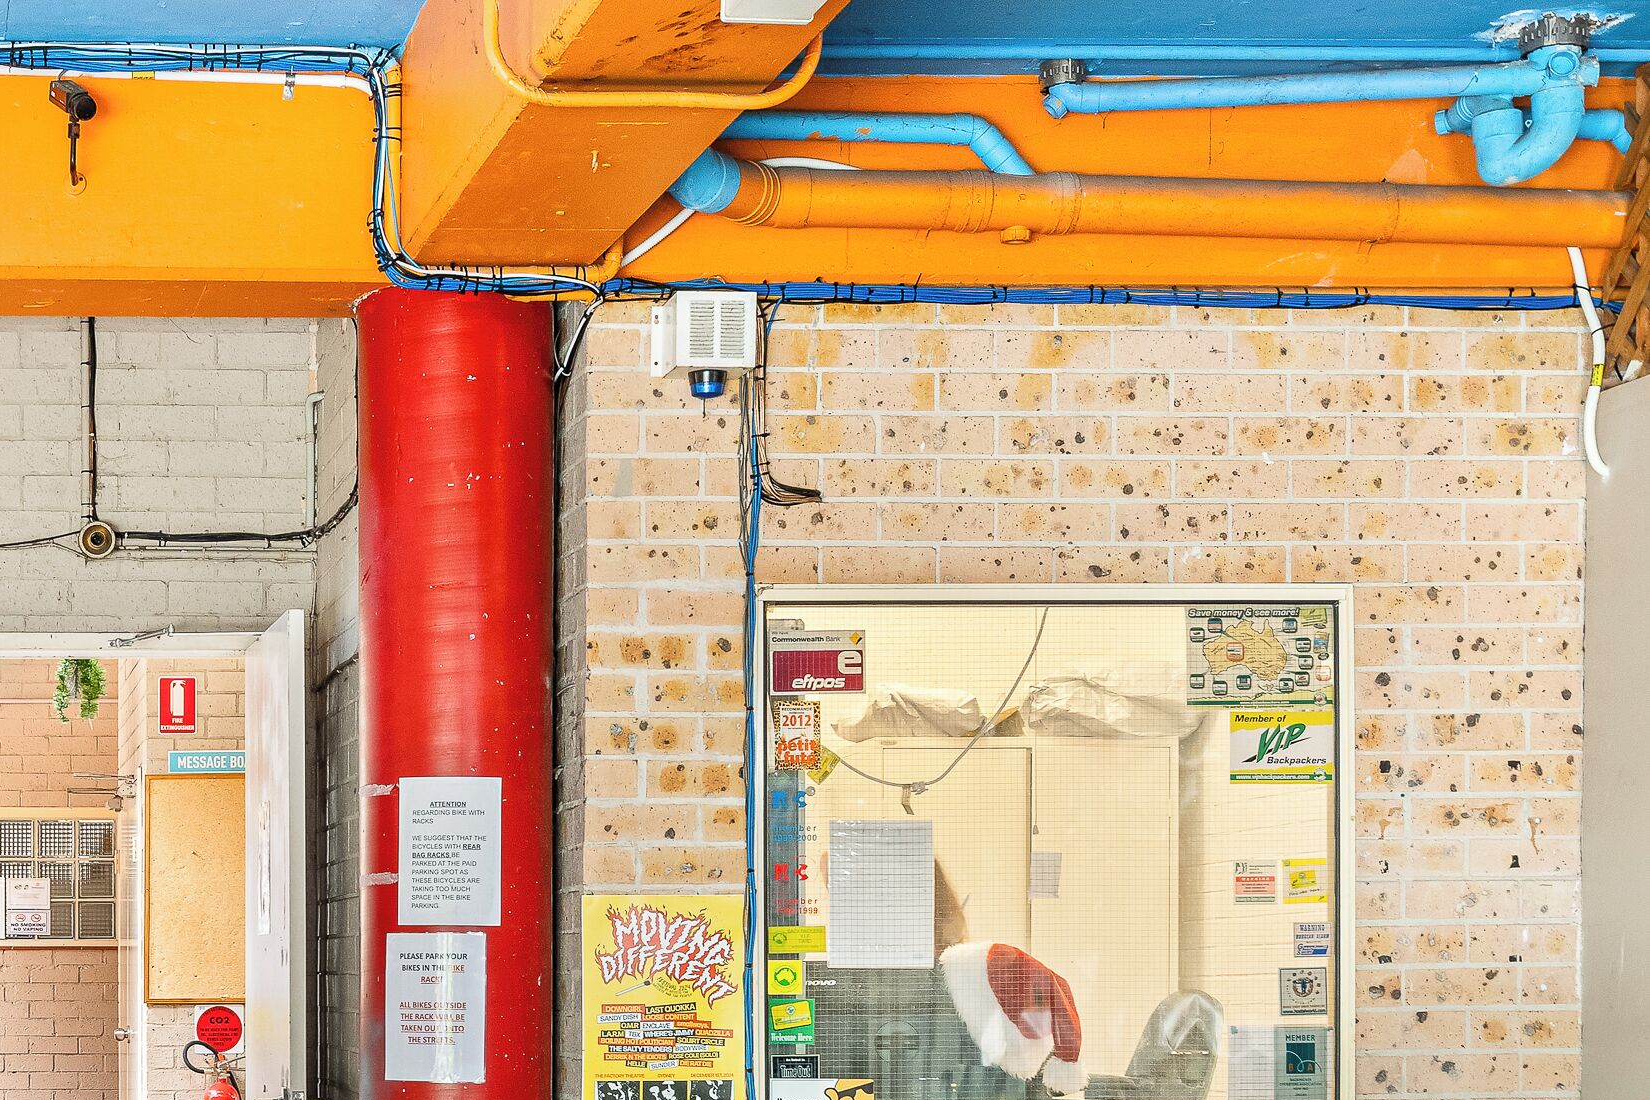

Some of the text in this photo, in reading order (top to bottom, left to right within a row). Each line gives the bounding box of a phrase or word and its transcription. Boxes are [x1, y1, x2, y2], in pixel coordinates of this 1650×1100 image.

[1188, 607, 1299, 618] Save money see more!
[772, 635, 841, 643] Commonwealth Bank
[837, 651, 862, 675] e
[792, 674, 846, 690] eftpos
[782, 715, 811, 727] 2012
[1235, 714, 1287, 723] Member of
[777, 738, 817, 756] petit
[178, 756, 245, 768] MESSAGE BO
[1267, 757, 1327, 766] Backpackers
[610, 908, 733, 967] MOVING
[600, 942, 738, 1008] DIFFERENT
[646, 1003, 695, 1014] LAST QUOKKA
[414, 1013, 434, 1021] RACK
[771, 1033, 812, 1041] Welcome Here
